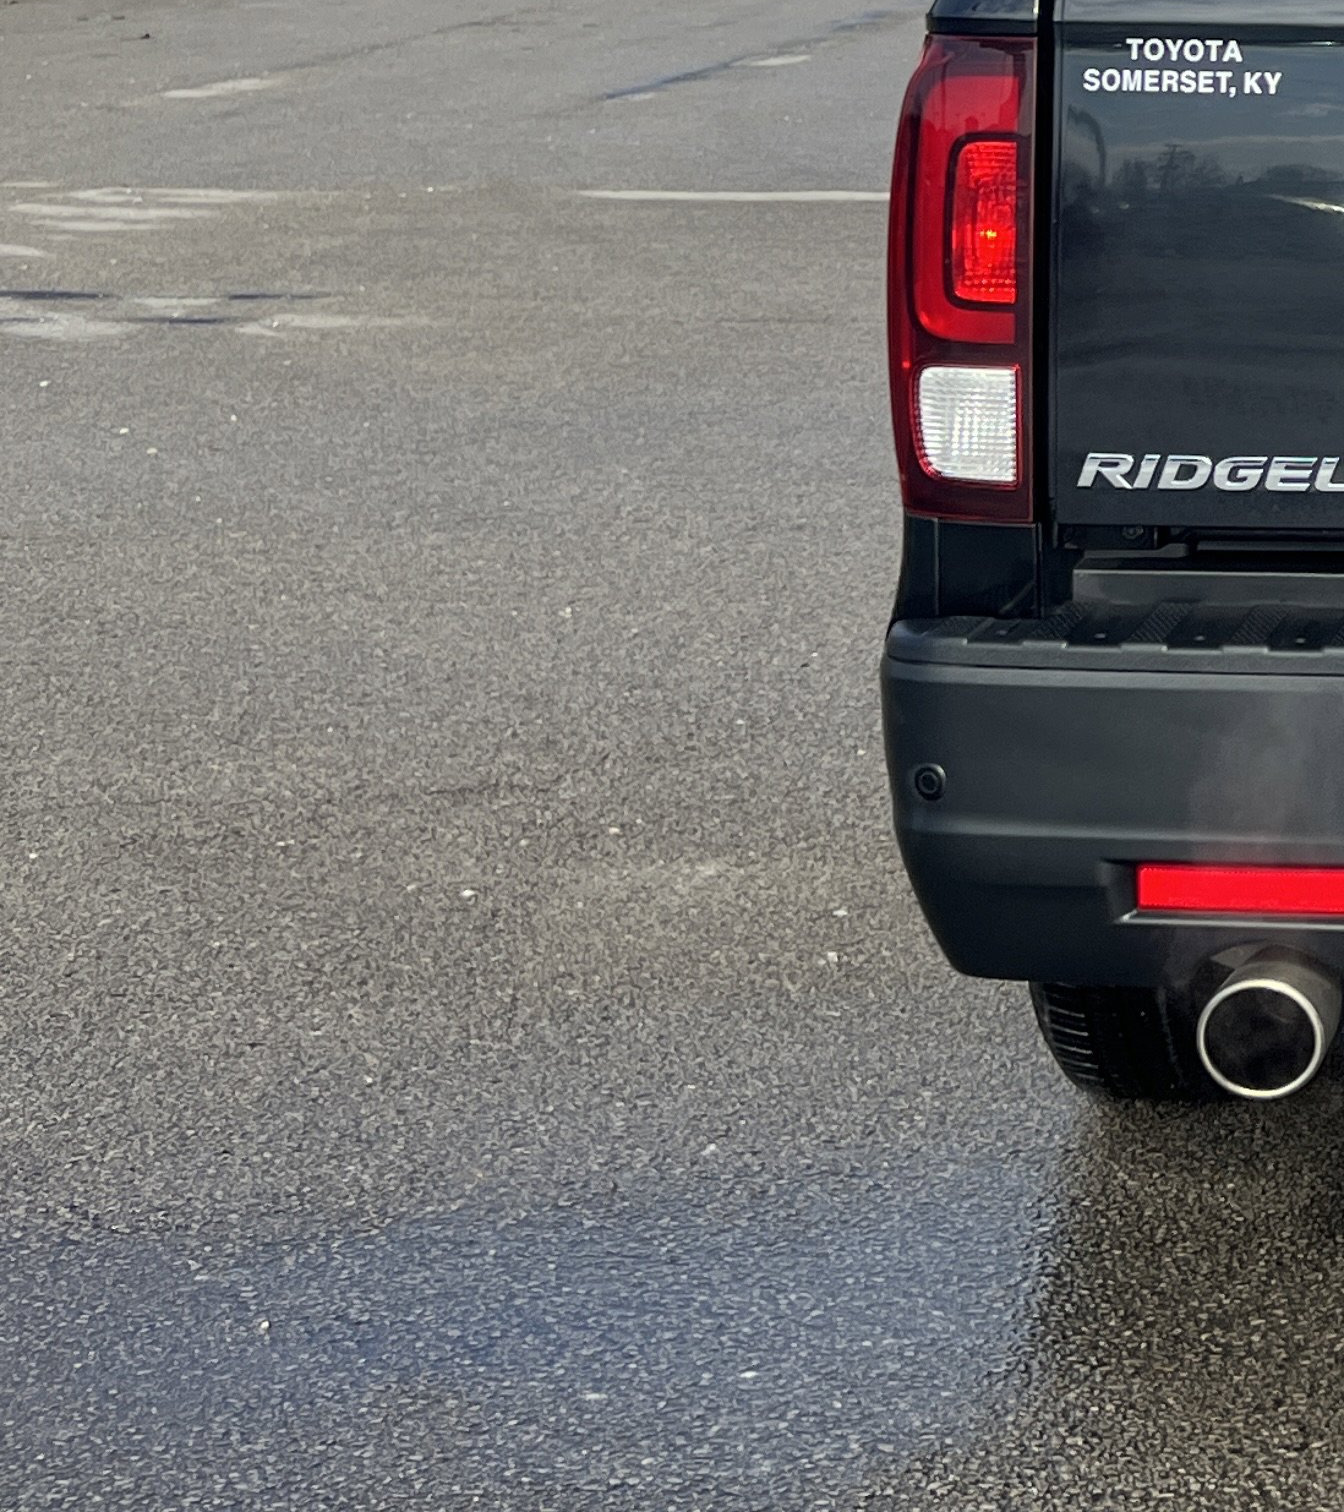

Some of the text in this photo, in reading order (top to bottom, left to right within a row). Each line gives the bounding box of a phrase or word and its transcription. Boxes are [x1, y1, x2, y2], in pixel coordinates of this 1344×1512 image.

[1126, 38, 1243, 62] TOYOTA
[1083, 68, 1282, 98] SOMERSET, KY
